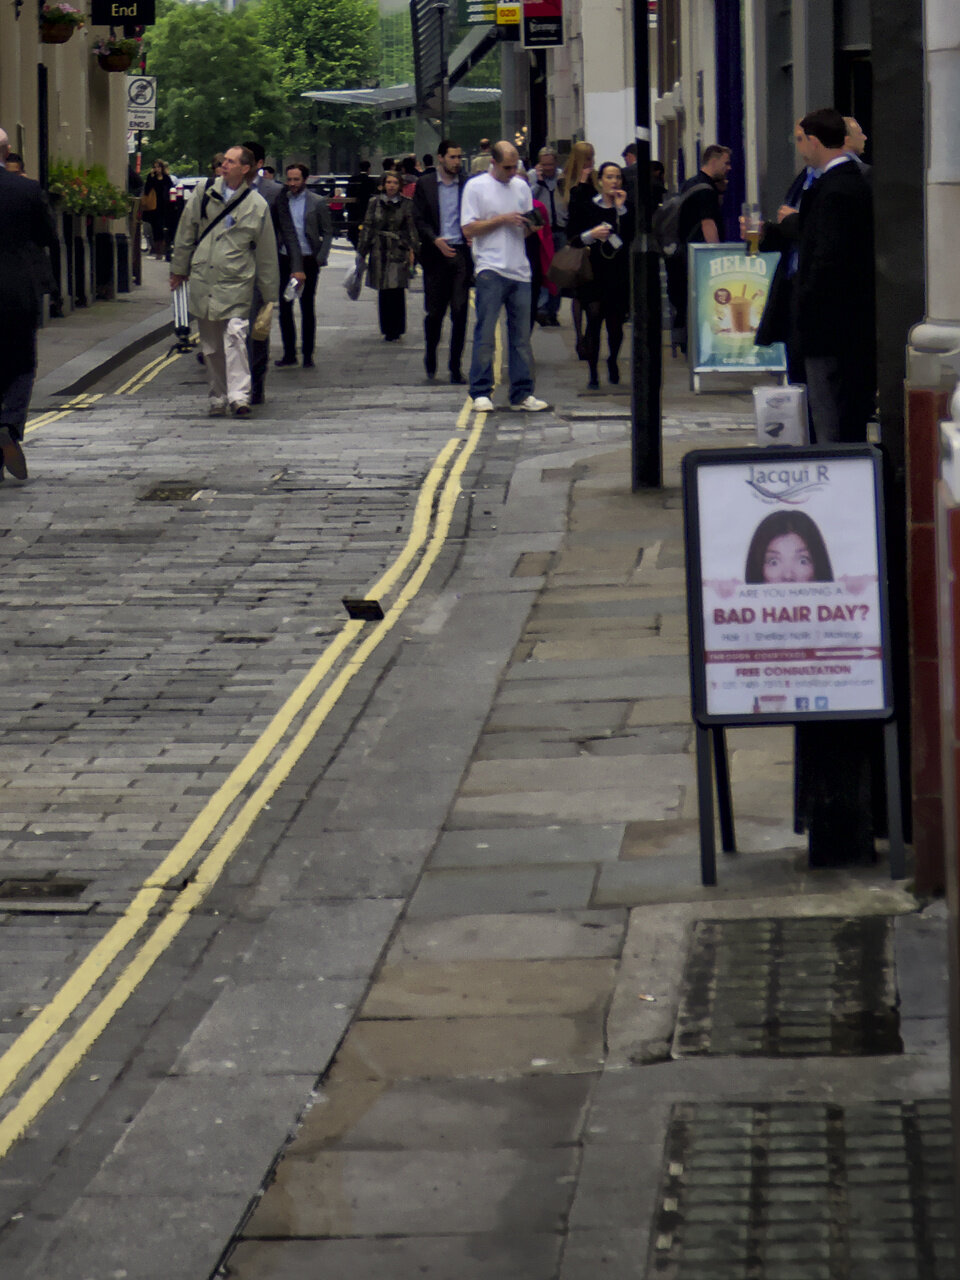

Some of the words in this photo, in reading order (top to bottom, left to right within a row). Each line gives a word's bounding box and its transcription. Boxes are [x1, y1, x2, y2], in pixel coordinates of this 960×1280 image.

[111, 3, 137, 16] End
[709, 255, 767, 276] HELLO
[747, 465, 810, 487] Jacqui
[817, 465, 830, 481] R
[740, 590, 758, 598] ARE
[763, 588, 785, 598] YOU
[790, 587, 833, 597] HAVING
[835, 587, 843, 595] A
[713, 608, 756, 625] BAD
[762, 606, 812, 623] HAIR
[817, 604, 870, 622] DAY?
[736, 667, 760, 677] FREE
